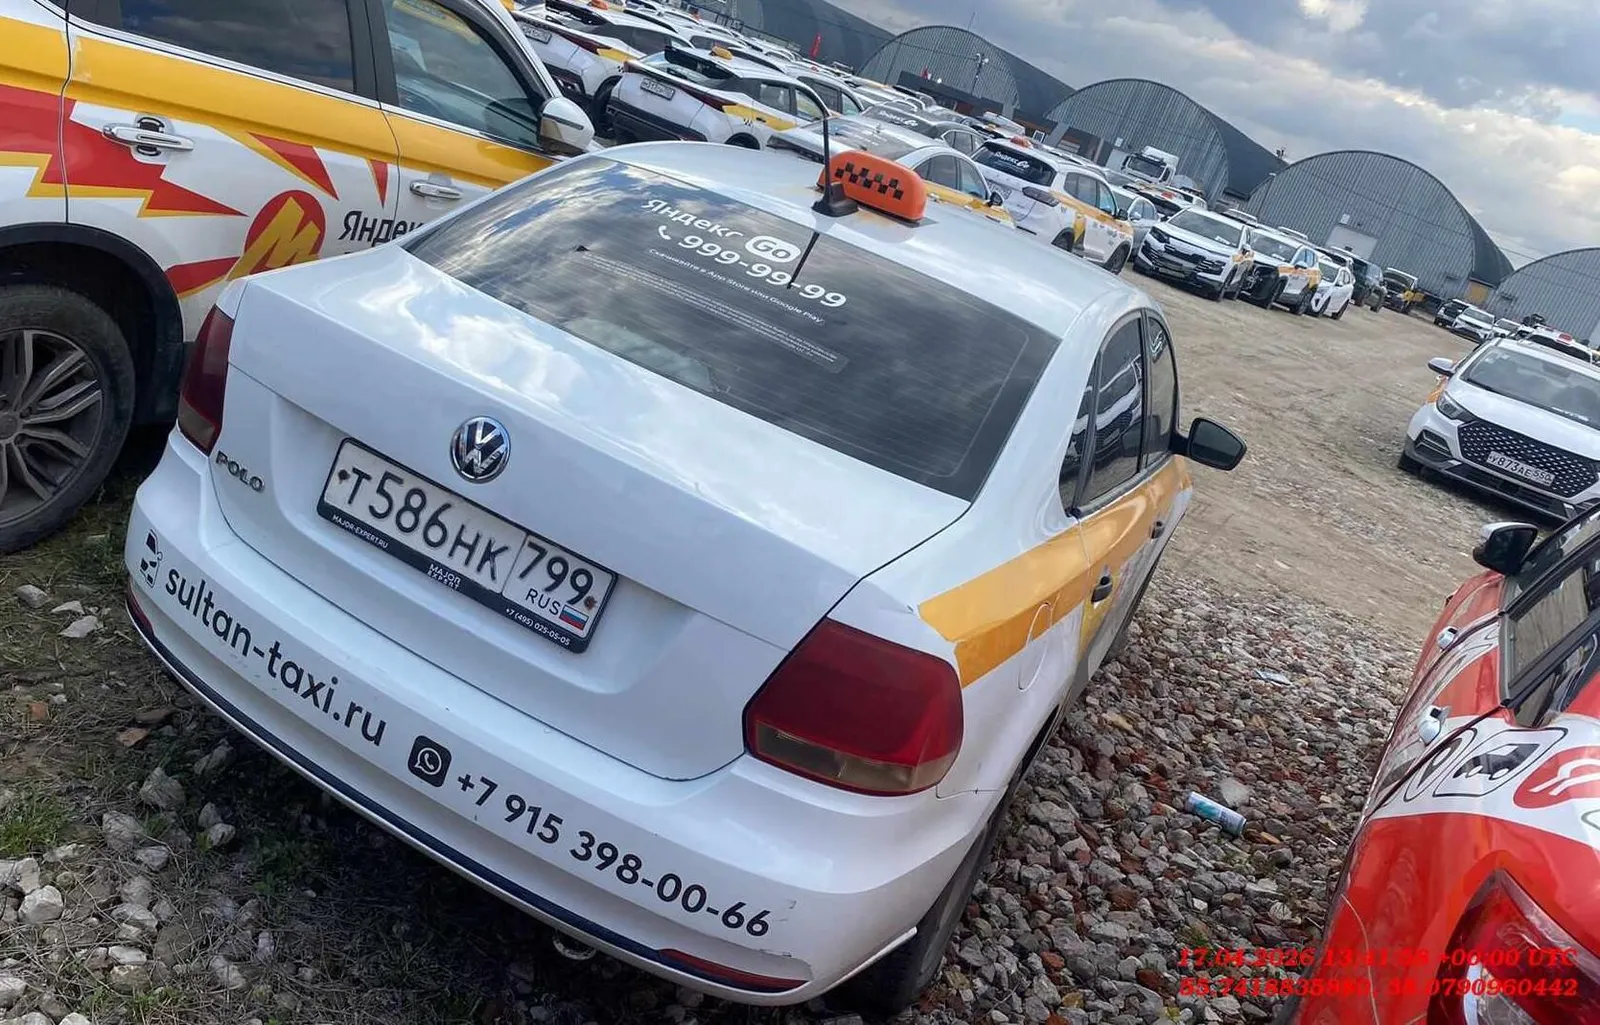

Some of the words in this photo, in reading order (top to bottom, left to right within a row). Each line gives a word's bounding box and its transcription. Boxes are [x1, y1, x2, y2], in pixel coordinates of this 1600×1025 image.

[750, 238, 793, 260] Go
[677, 235, 847, 308] 999-99-99
[769, 296, 802, 315] Google
[803, 310, 825, 324] Play
[215, 450, 265, 492] POLO
[332, 514, 389, 549] MAJOR-EXPERT.RU
[429, 563, 462, 585] MAJOR
[518, 540, 594, 605] 799
[525, 588, 561, 615] RUS
[514, 612, 534, 627] (495)
[533, 622, 571, 646] 025-05-05
[165, 568, 387, 747] sultan-taxi.ru
[457, 773, 499, 807] +7
[504, 794, 564, 844] 915
[569, 830, 771, 937] 398-00-66
